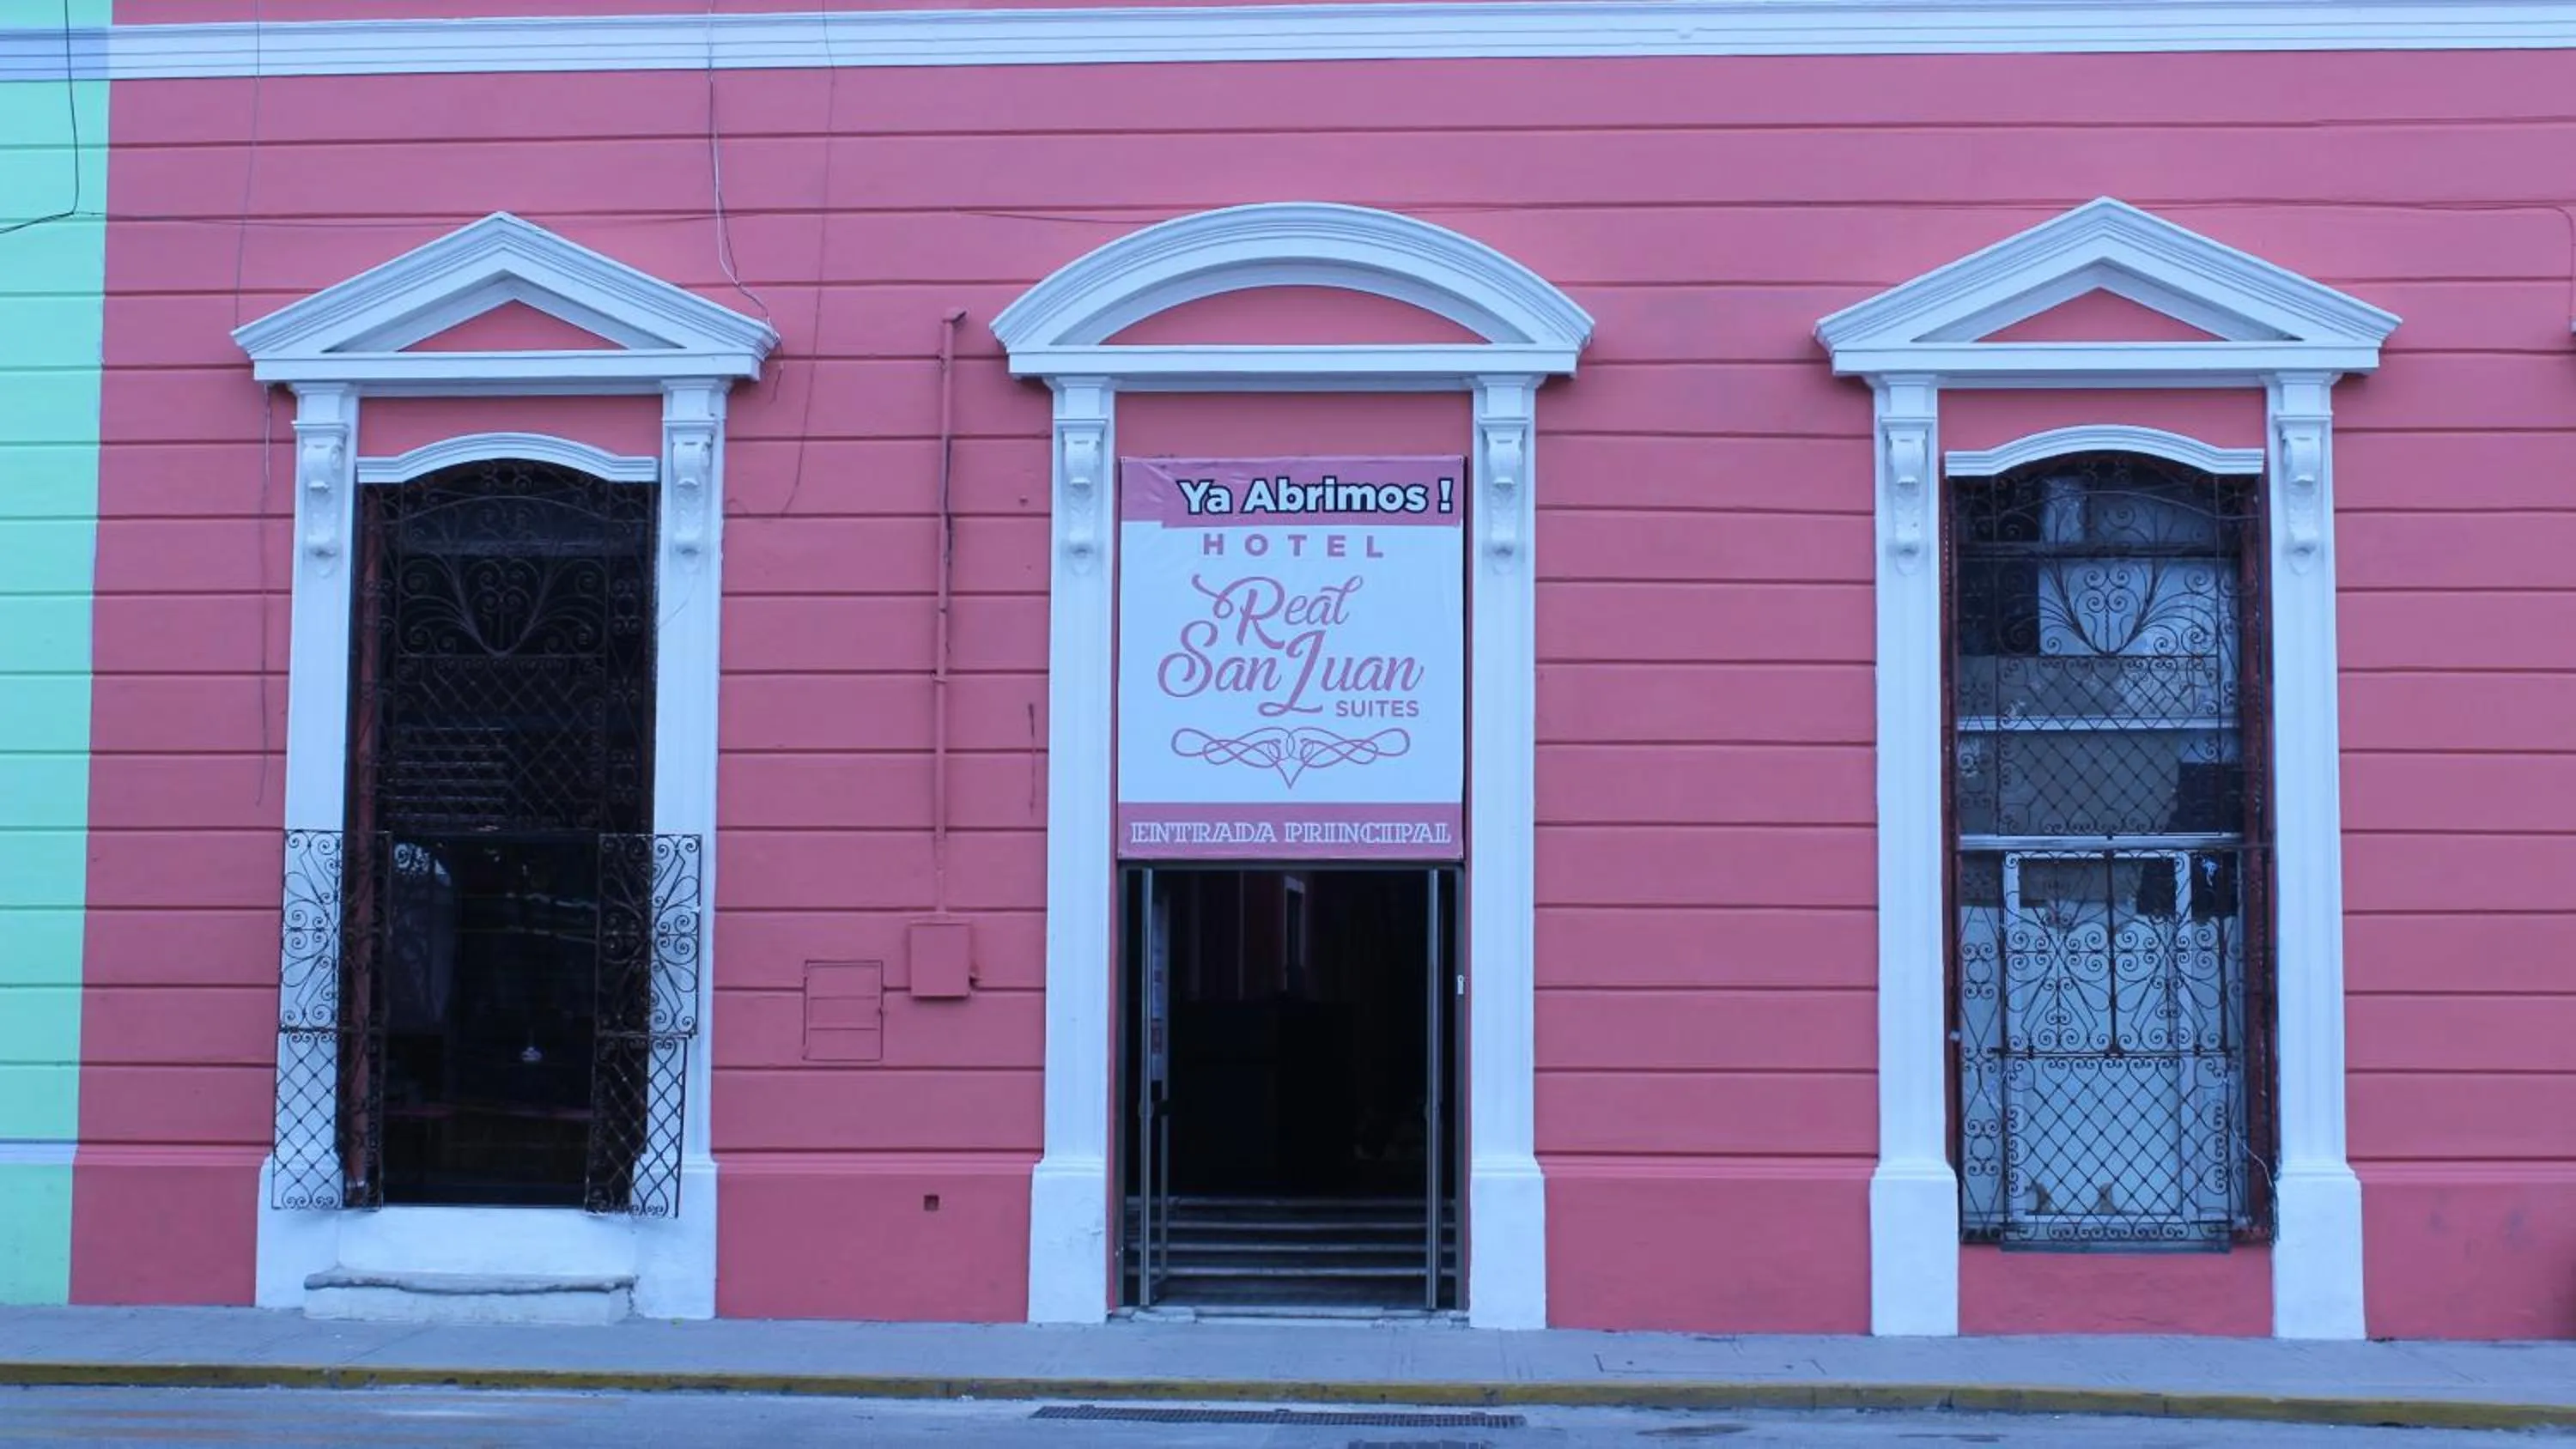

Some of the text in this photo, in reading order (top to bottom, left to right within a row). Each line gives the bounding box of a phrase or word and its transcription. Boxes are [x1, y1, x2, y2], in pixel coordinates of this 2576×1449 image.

[1177, 479, 1232, 514] Ya
[1241, 476, 1428, 513] Abrimos
[1203, 533, 1383, 558] HOTEL
[1192, 574, 1364, 650] Real
[1157, 621, 1424, 717] San Juan
[1336, 700, 1419, 717] SUITES
[1131, 822, 1451, 843] ENTRADA PRINCIPAL
